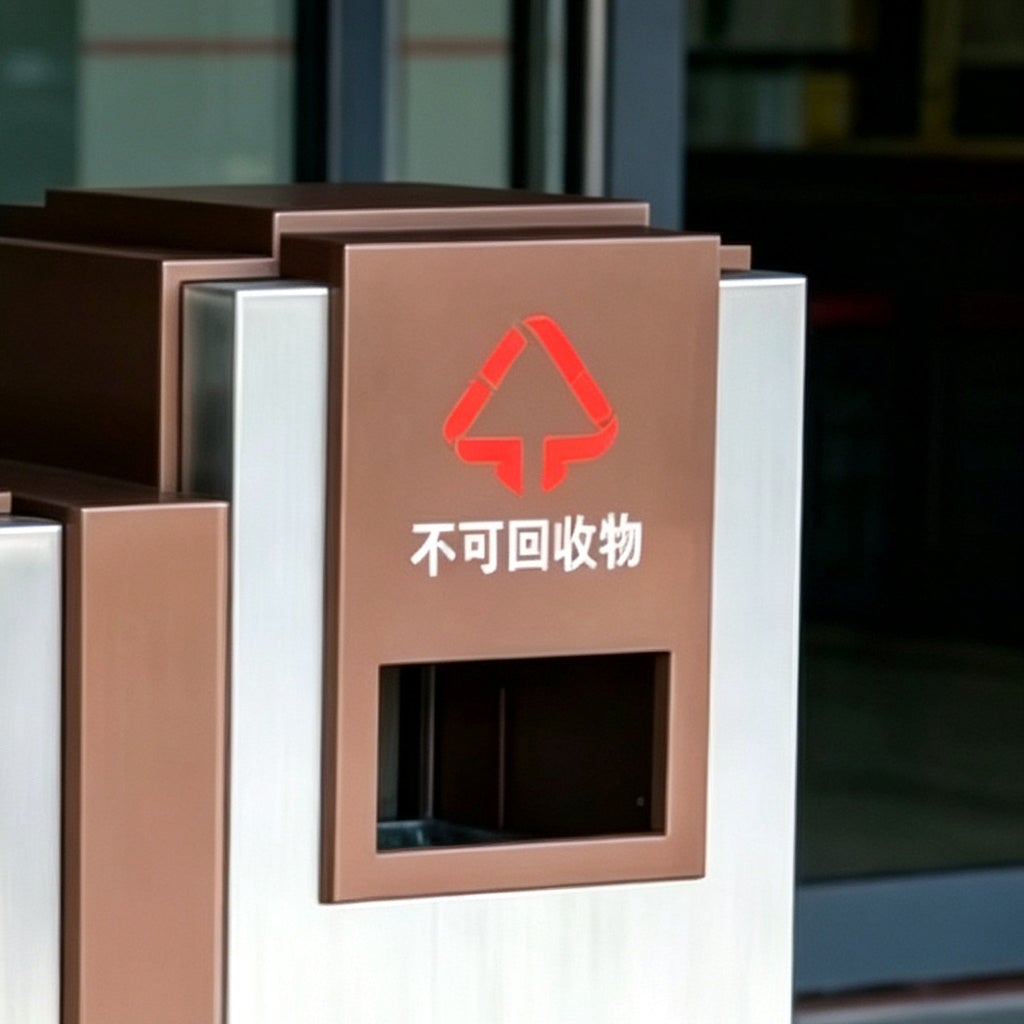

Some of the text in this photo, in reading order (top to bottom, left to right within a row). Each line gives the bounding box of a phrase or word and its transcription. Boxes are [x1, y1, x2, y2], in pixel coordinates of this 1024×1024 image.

[410, 512, 642, 577] 不可回收物
